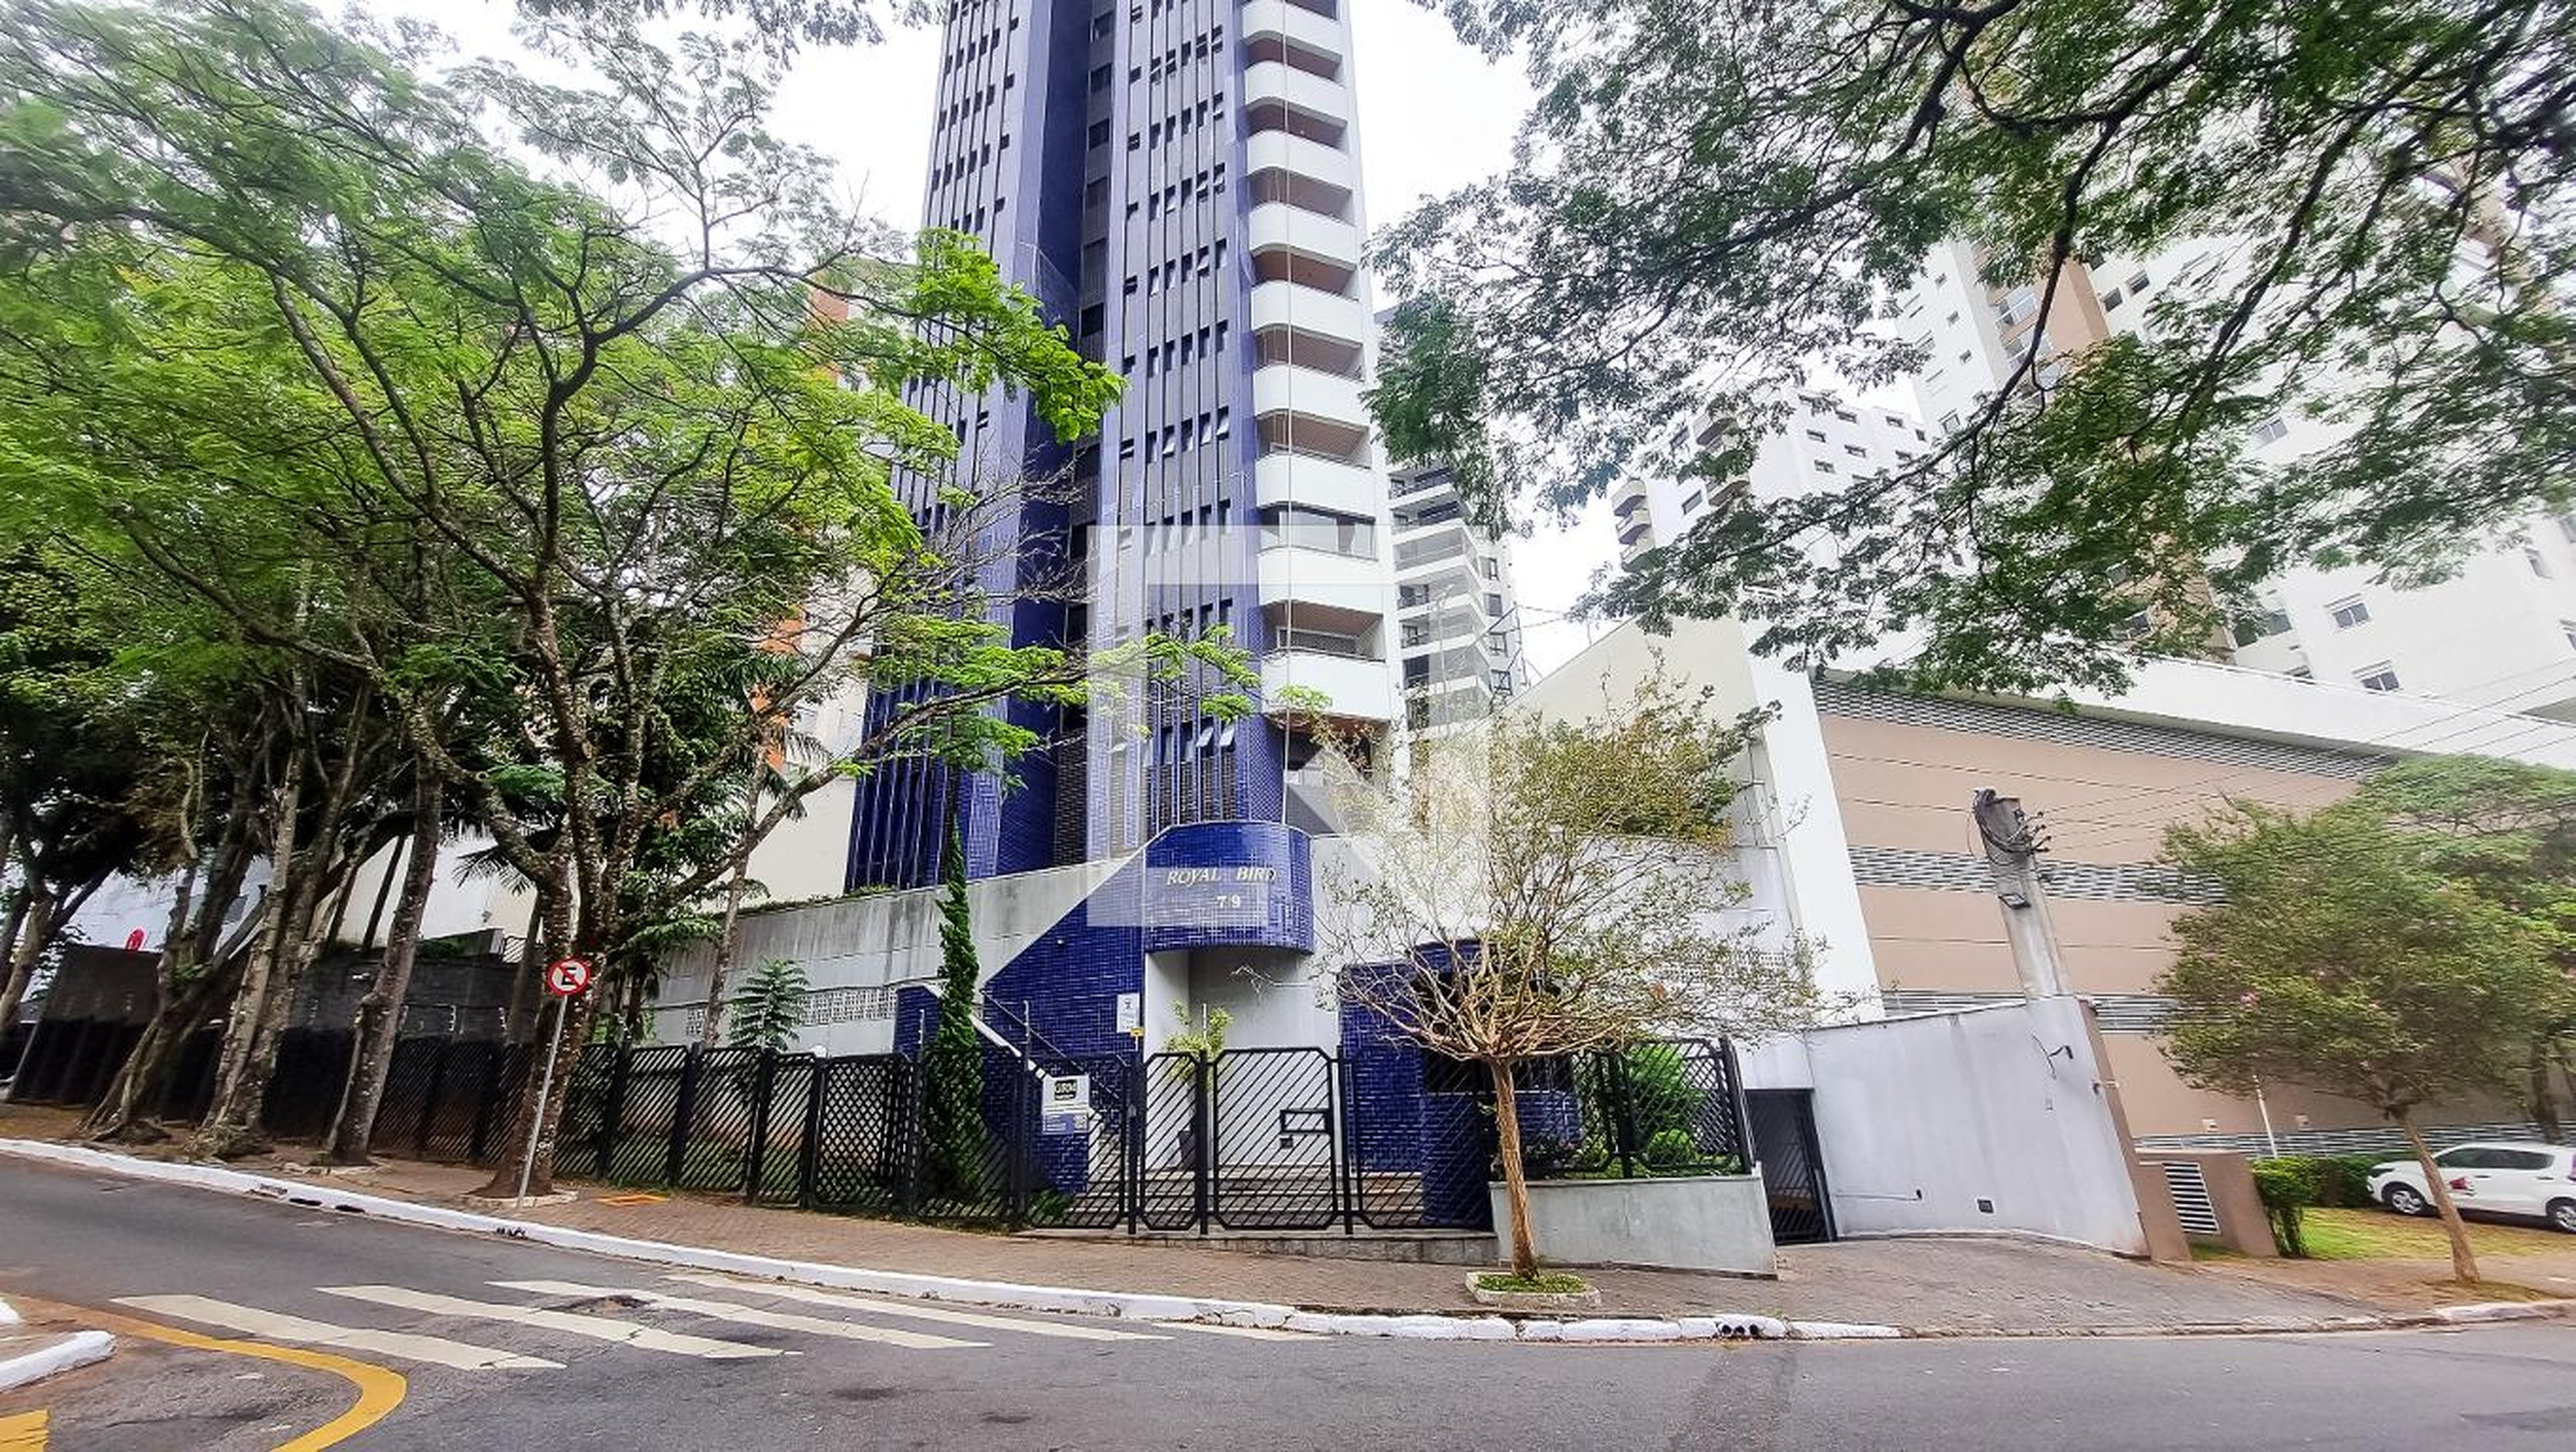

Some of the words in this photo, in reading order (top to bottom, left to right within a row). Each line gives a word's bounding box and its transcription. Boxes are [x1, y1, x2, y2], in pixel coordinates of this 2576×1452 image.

[1166, 868, 1221, 887] ROYAL
[1236, 866, 1276, 881] BIRD
[561, 967, 577, 986] E
